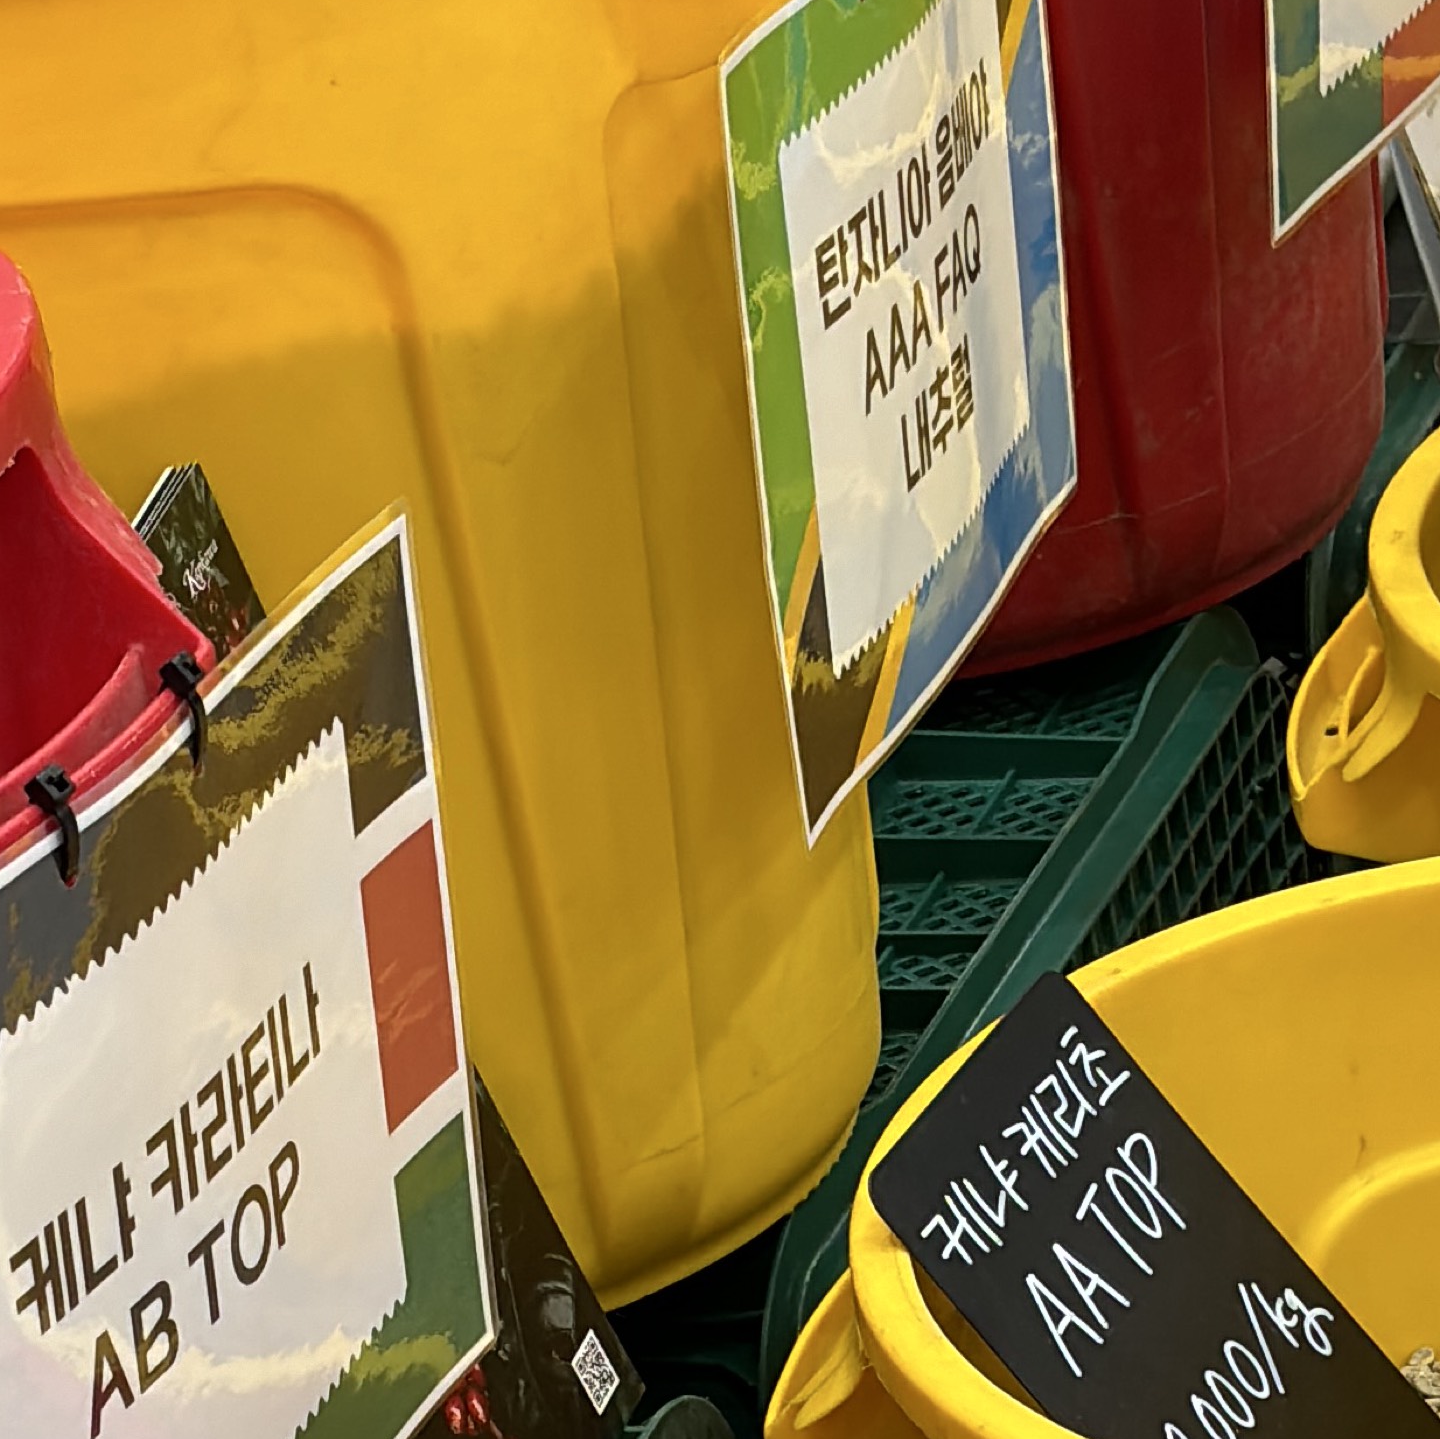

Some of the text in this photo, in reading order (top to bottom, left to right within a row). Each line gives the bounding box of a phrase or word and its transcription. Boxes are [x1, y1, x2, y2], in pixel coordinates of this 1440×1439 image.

[815, 58, 991, 330] 탄자니아 음베야
[866, 203, 981, 416] AAA FAQ
[901, 334, 974, 493] 내추럴
[9, 960, 320, 1335] 케냐 카라티나
[187, 1140, 300, 1325] TOP
[921, 1144, 1029, 1266] 케냐
[1025, 1133, 1186, 1378] AA TOP
